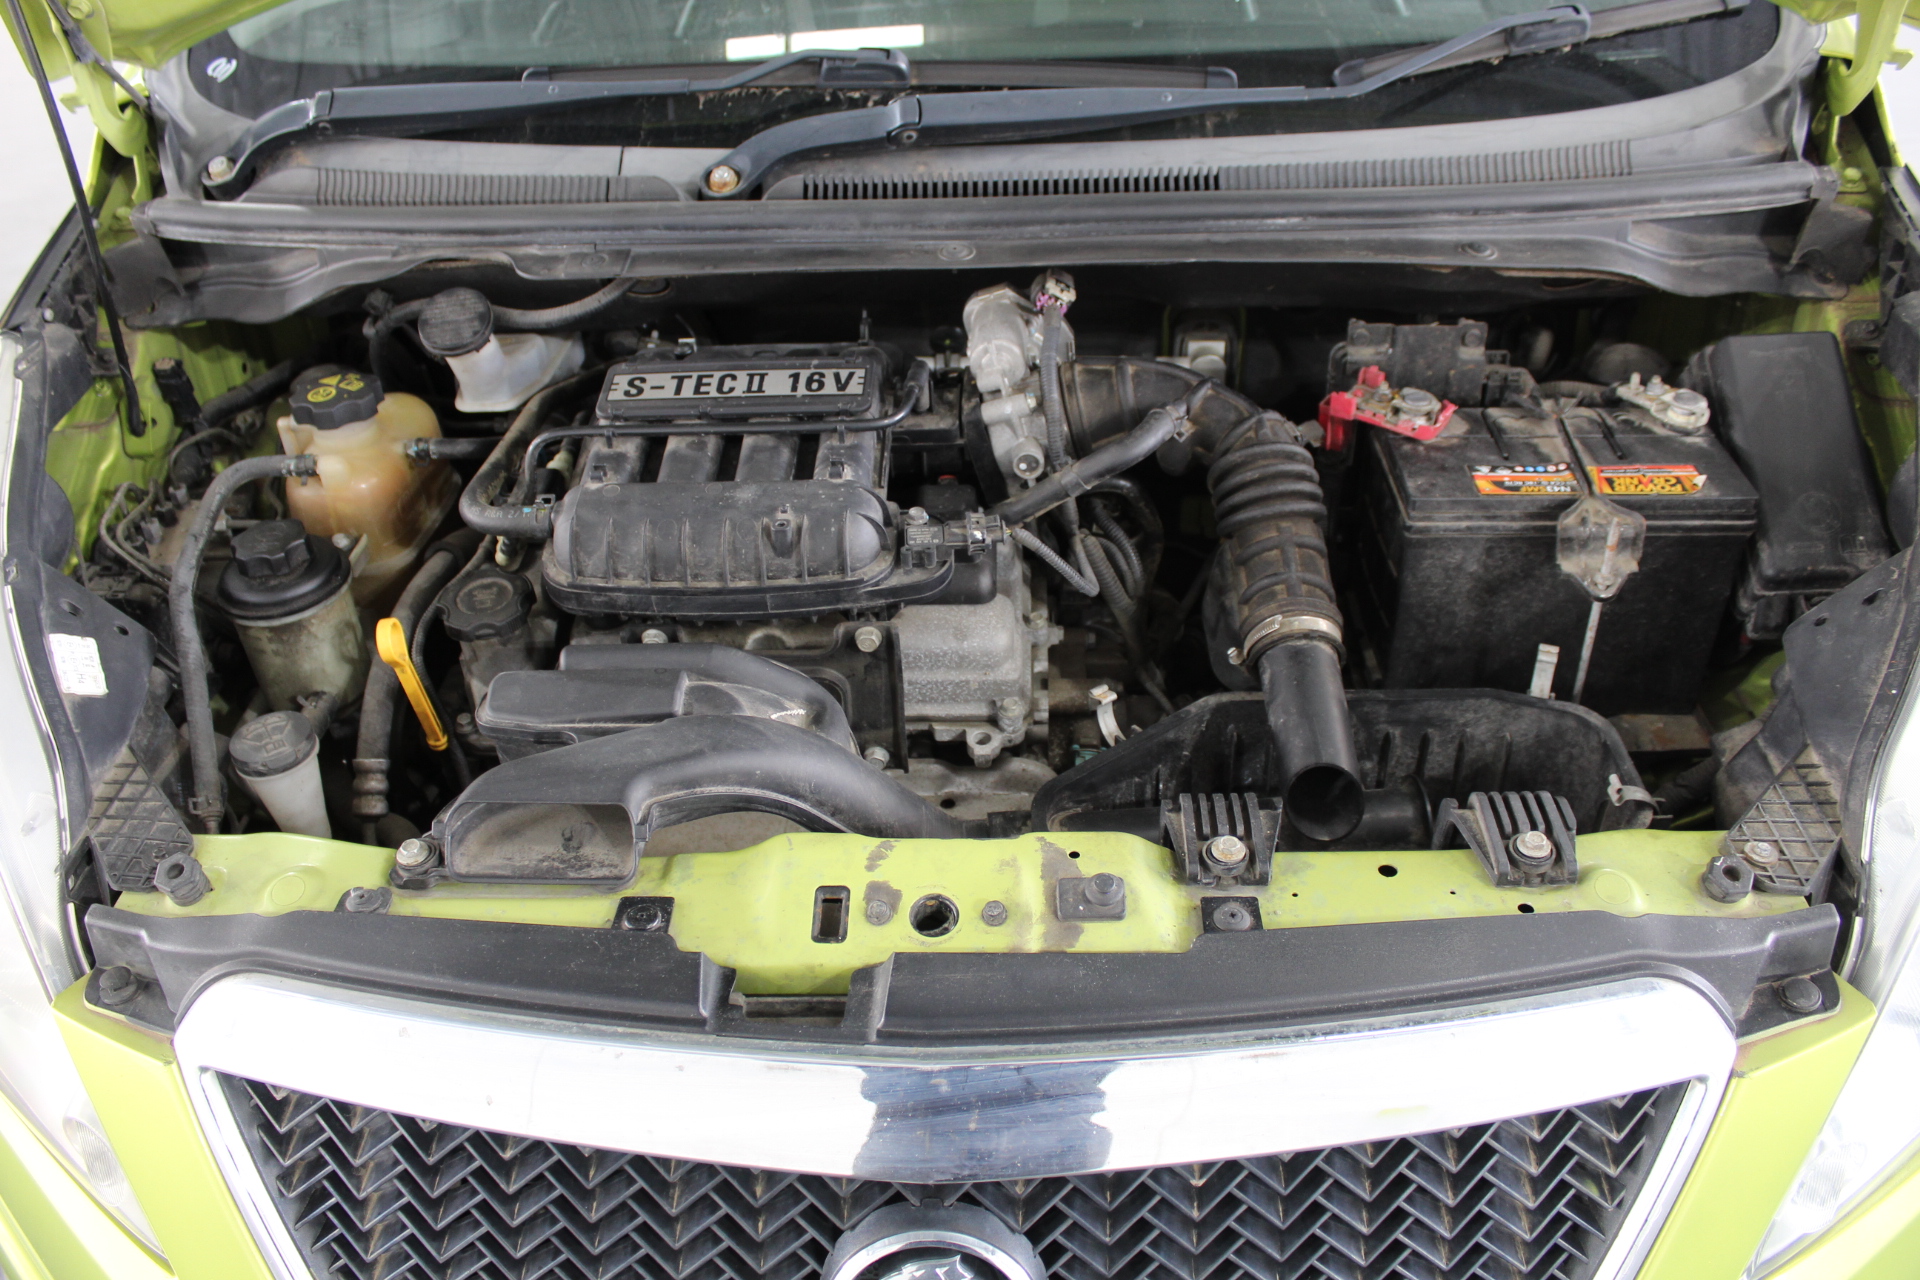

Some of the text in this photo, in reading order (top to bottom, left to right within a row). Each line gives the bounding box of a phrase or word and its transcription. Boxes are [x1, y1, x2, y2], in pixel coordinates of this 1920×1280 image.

[788, 371, 856, 393] 16V
[1612, 475, 1677, 486] CRANK
[1613, 484, 1683, 493] POWER
